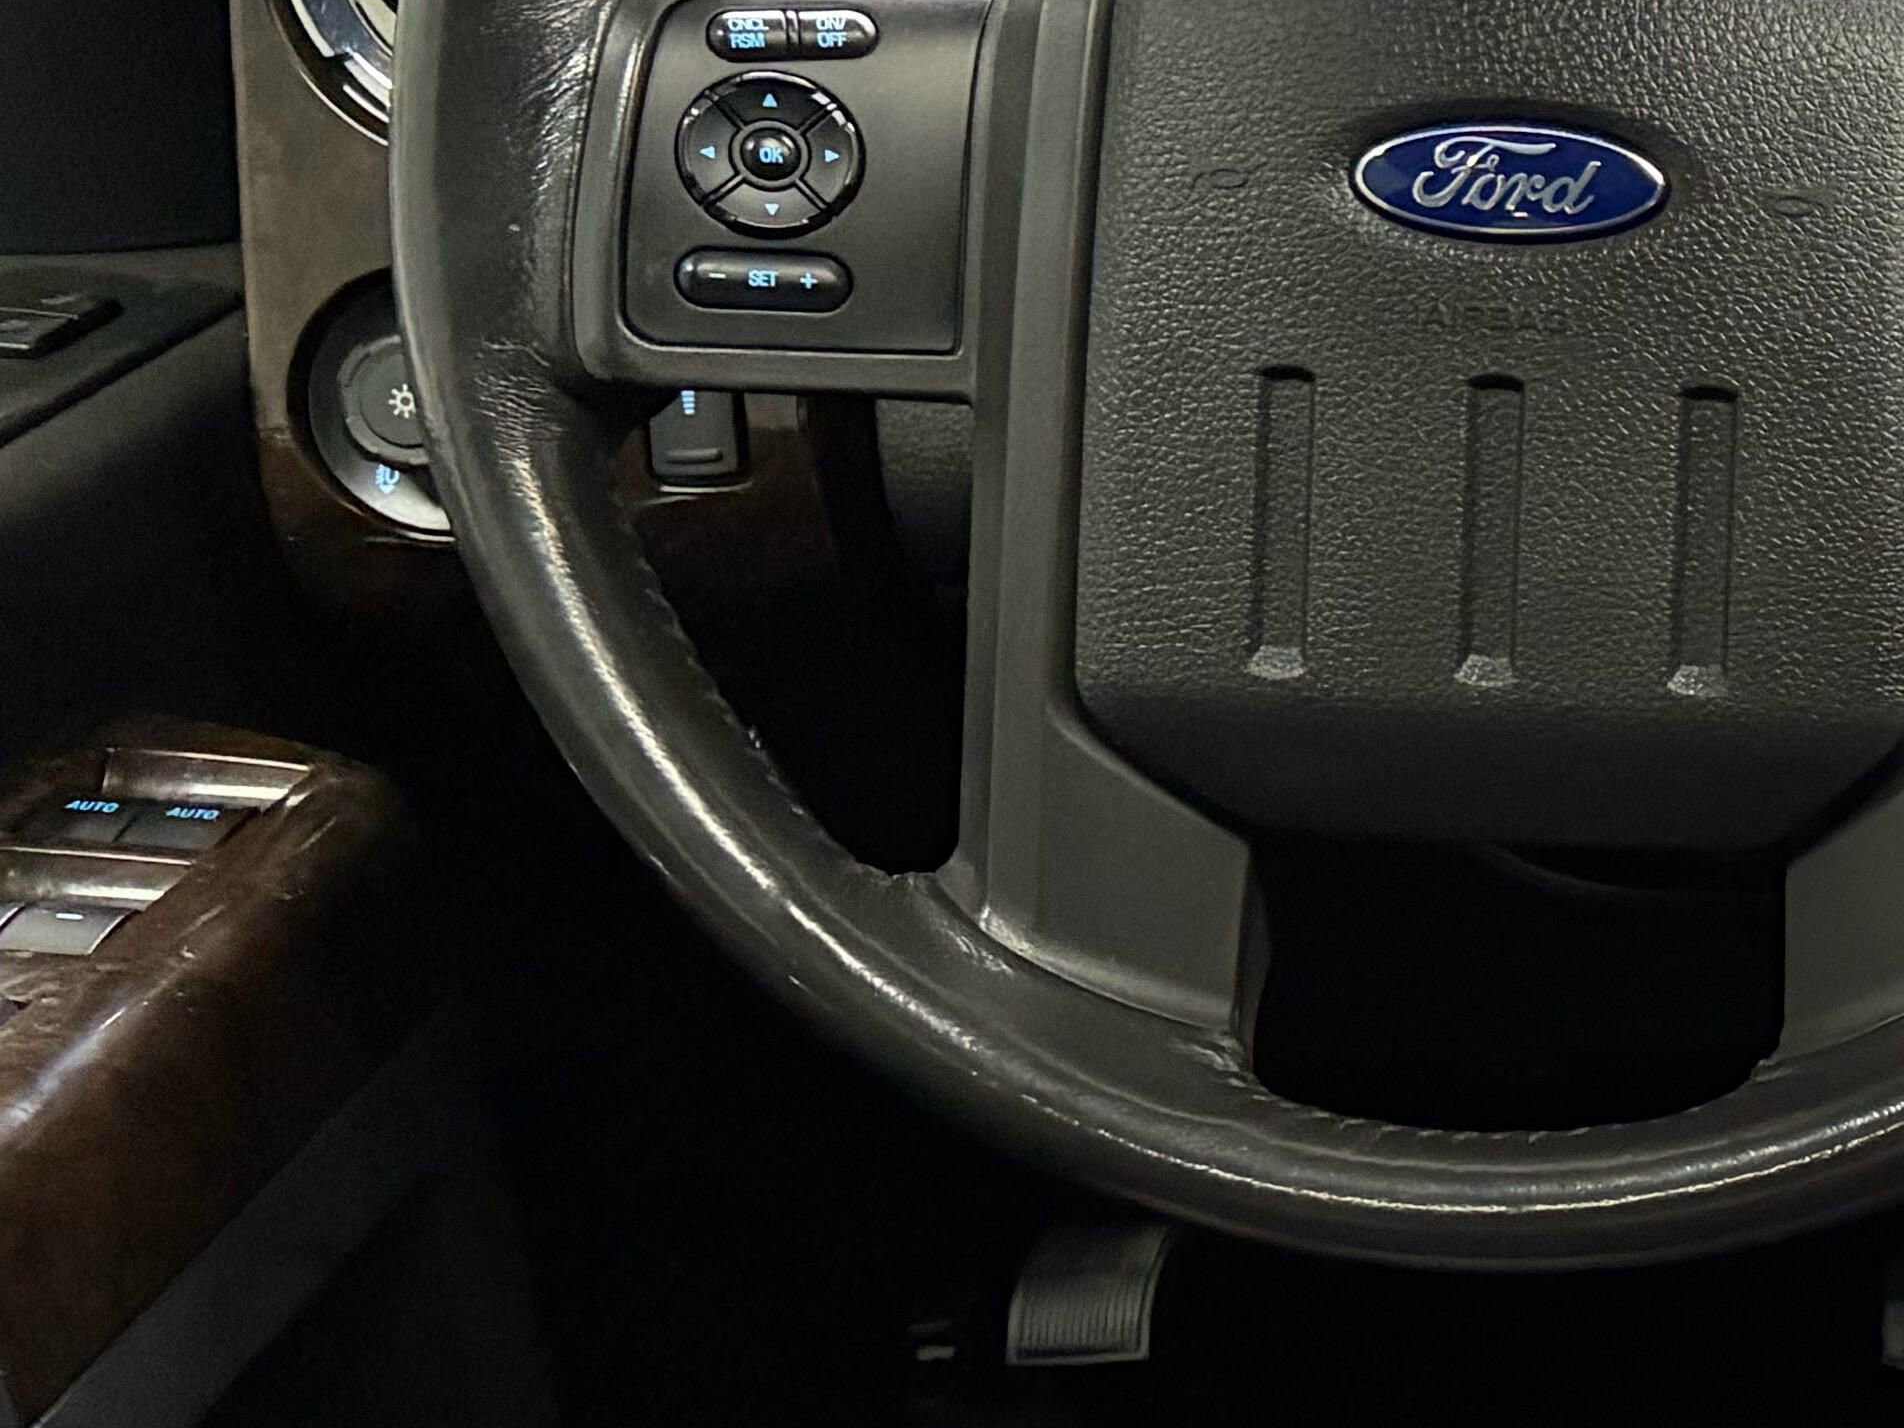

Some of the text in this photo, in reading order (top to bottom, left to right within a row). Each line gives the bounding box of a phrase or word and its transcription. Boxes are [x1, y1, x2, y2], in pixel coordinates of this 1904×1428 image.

[727, 17, 769, 32] CNCL
[730, 33, 766, 49] RSM
[817, 32, 847, 47] OFF
[759, 147, 784, 164] OK
[1411, 134, 1602, 217] Ford
[748, 270, 779, 288] SET
[64, 799, 121, 814] AUTO
[165, 806, 221, 821] AUTO
